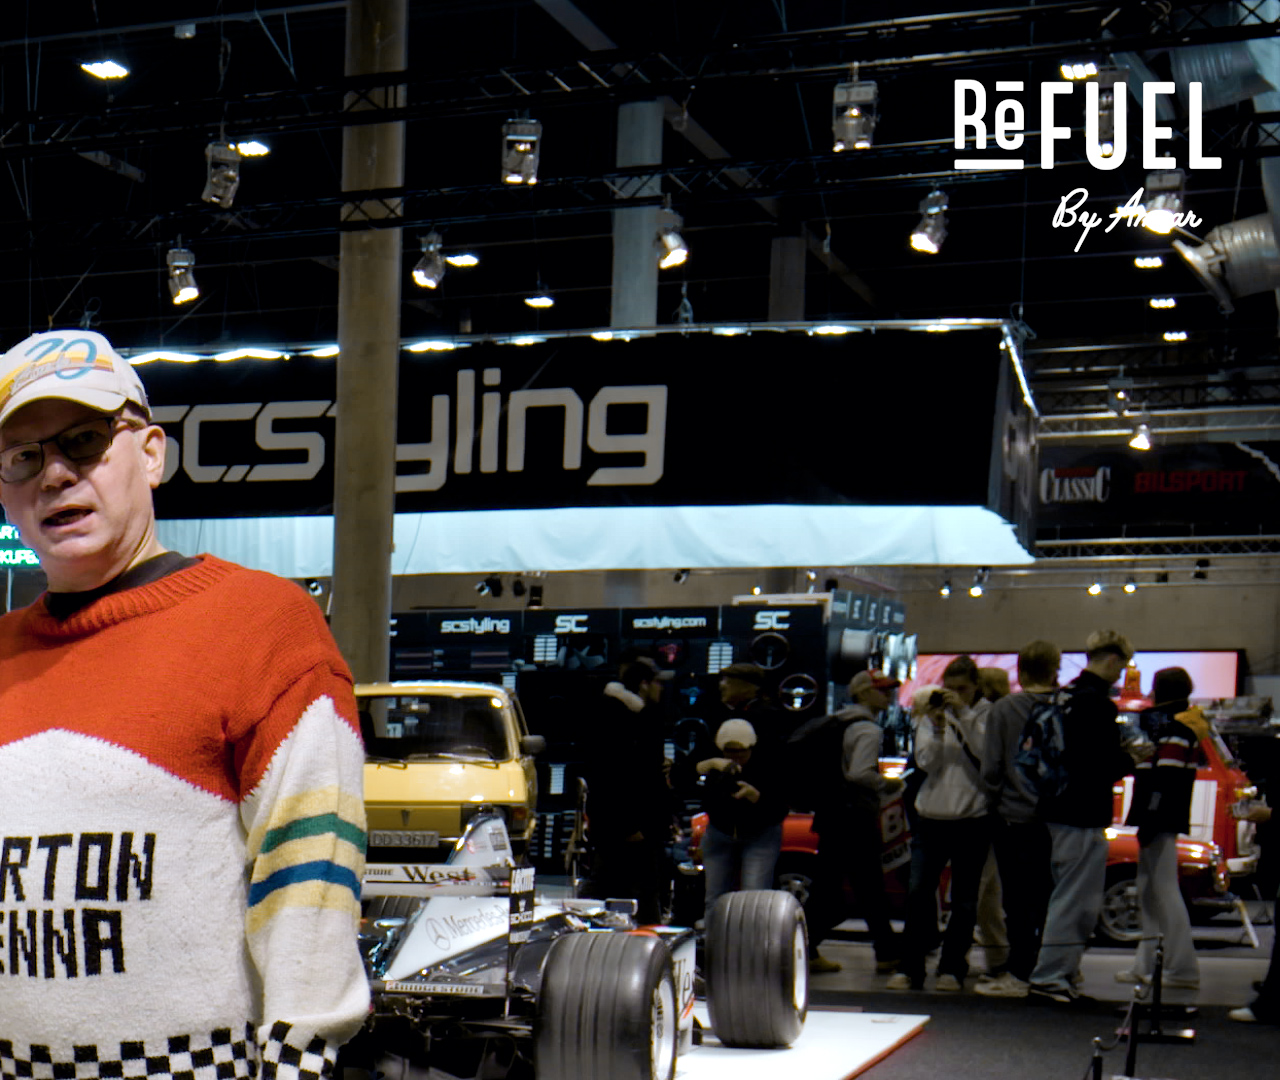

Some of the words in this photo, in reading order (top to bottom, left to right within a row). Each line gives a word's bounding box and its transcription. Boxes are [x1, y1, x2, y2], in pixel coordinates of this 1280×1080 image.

[1041, 466, 1111, 504] CLASSIC
[1134, 470, 1249, 493] BILSPORT
[440, 617, 510, 634] scstyling
[554, 614, 588, 634] SC
[753, 610, 791, 630] SC
[401, 865, 473, 883] West
